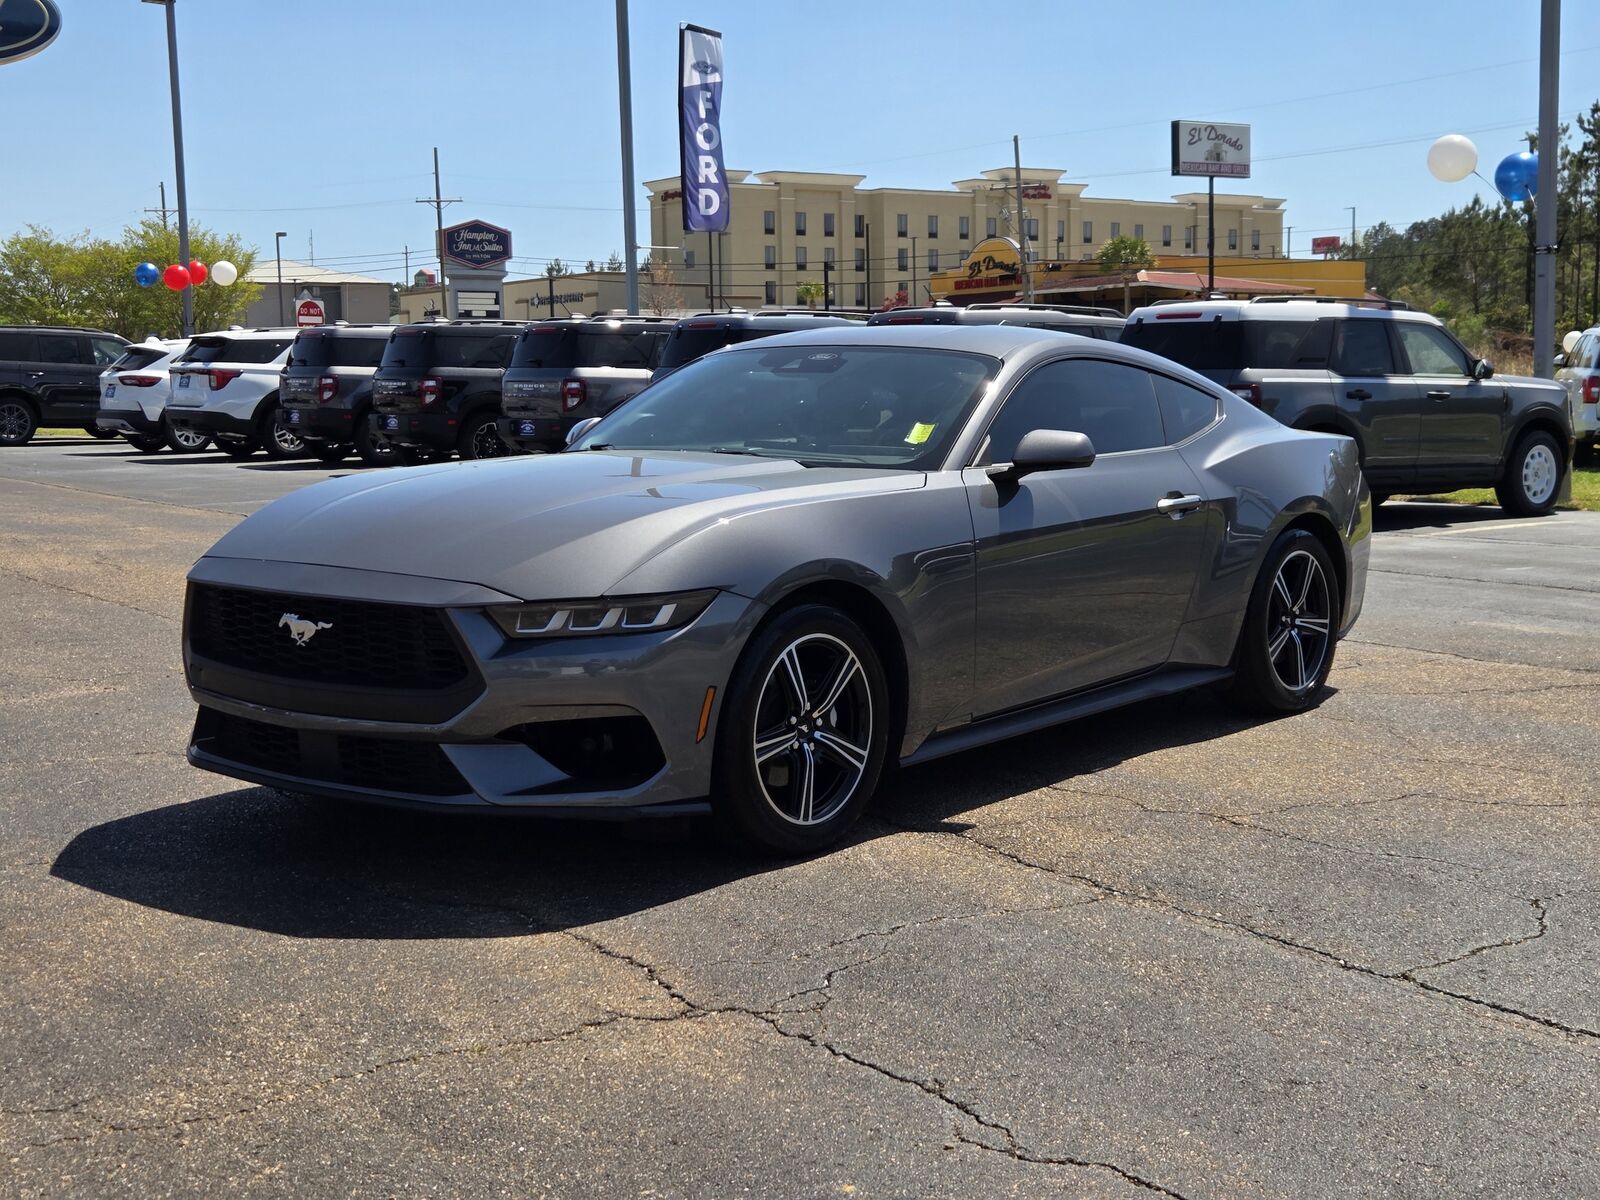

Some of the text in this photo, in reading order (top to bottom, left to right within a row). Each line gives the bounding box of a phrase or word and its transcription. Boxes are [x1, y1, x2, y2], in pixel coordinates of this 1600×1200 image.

[1187, 124, 1244, 152] El Dorado
[696, 89, 720, 216] FORD
[455, 229, 499, 242] Hampton
[453, 240, 474, 252] Inn
[480, 241, 503, 252] Suites
[968, 260, 982, 278] El
